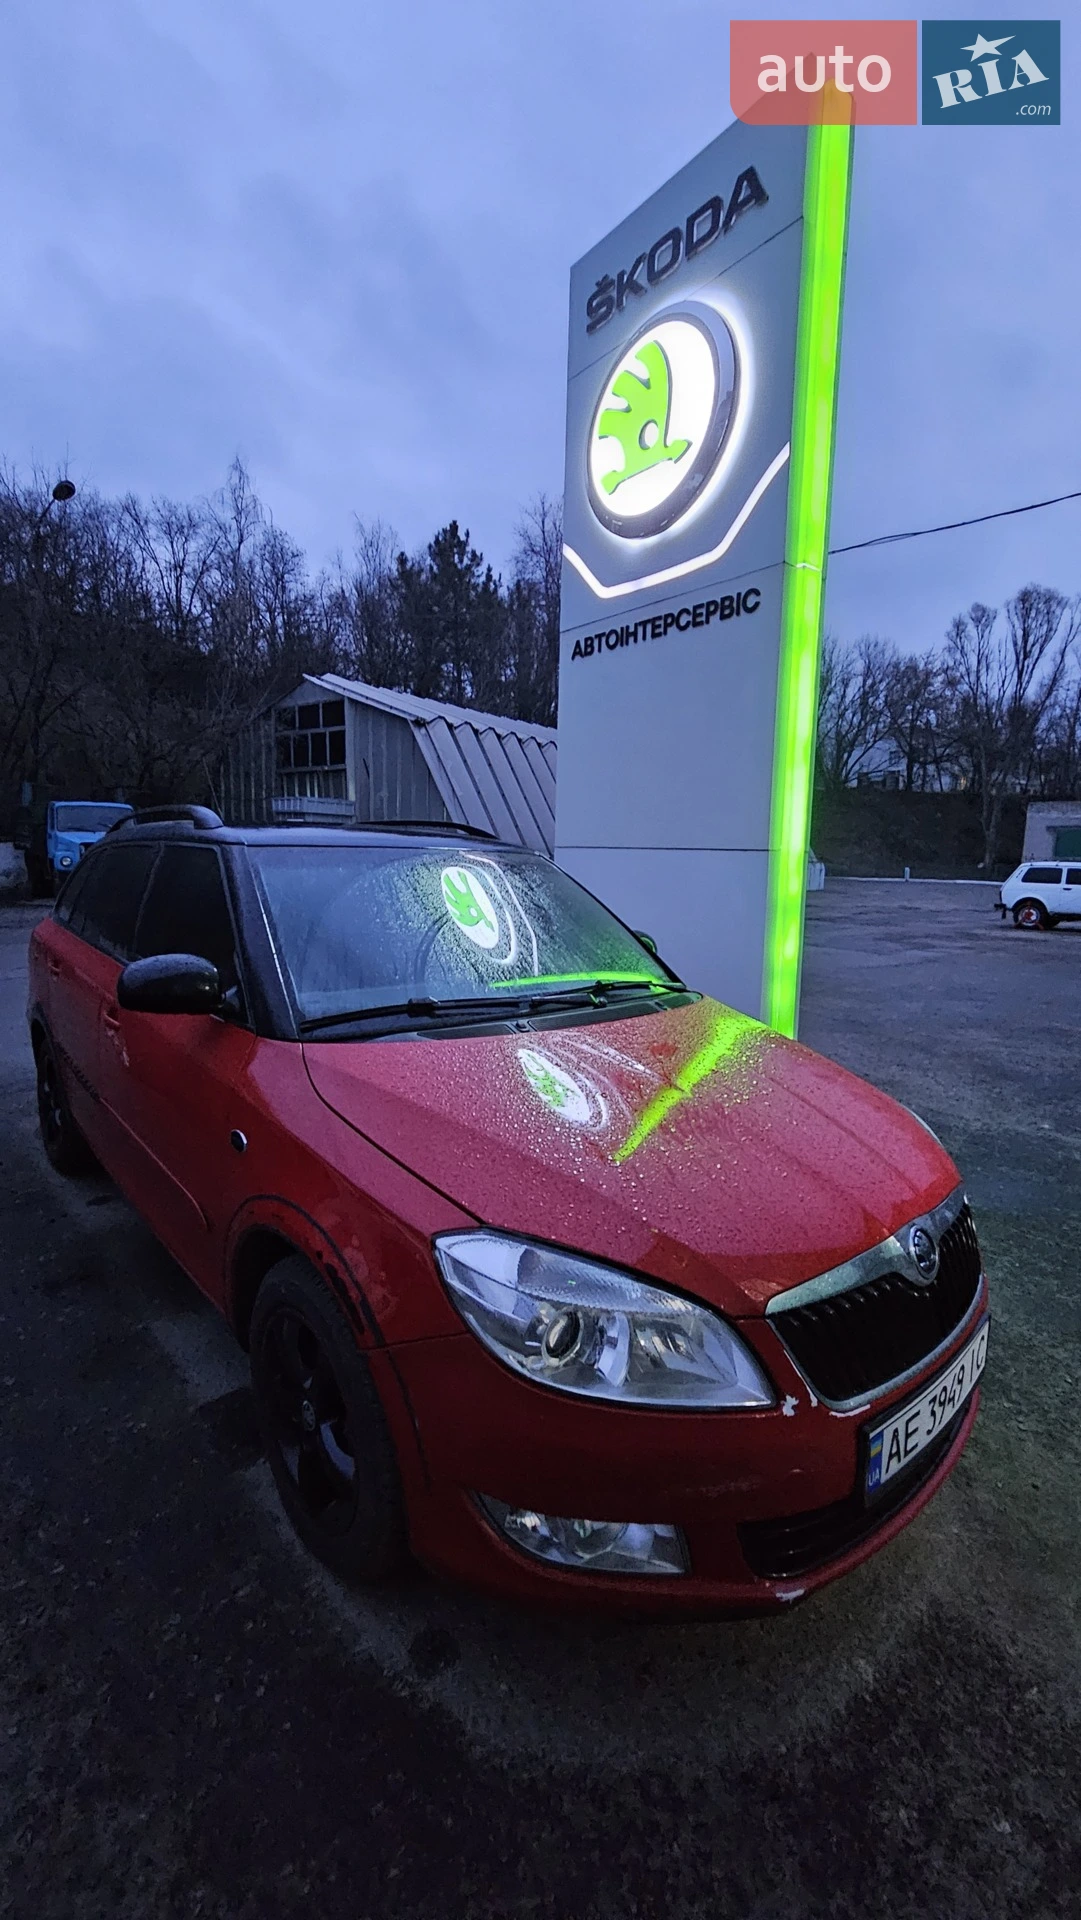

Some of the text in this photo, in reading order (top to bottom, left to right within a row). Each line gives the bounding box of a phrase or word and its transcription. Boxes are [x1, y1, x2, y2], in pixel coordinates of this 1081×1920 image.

[586, 165, 769, 333] ŠKODA
[571, 587, 761, 661] АВТОІНТЕРСЕРВІС
[885, 1335, 985, 1474] AE 3949 IC
